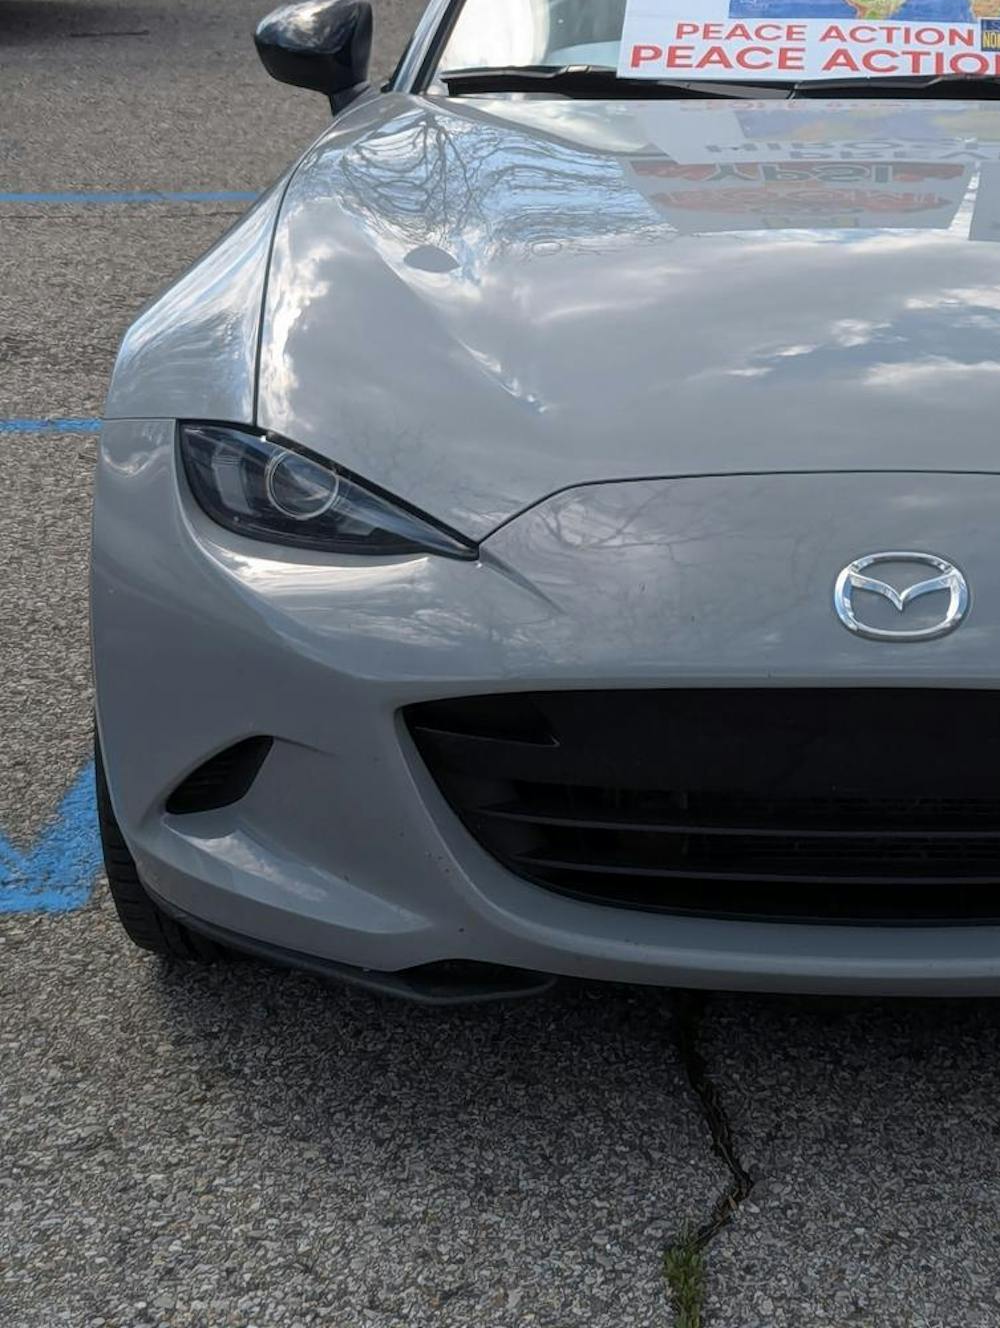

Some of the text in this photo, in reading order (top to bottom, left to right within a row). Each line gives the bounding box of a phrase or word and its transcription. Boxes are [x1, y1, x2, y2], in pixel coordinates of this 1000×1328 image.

[676, 22, 807, 42] PEACE
[819, 25, 974, 47] ACTION
[630, 44, 807, 70] PEACE
